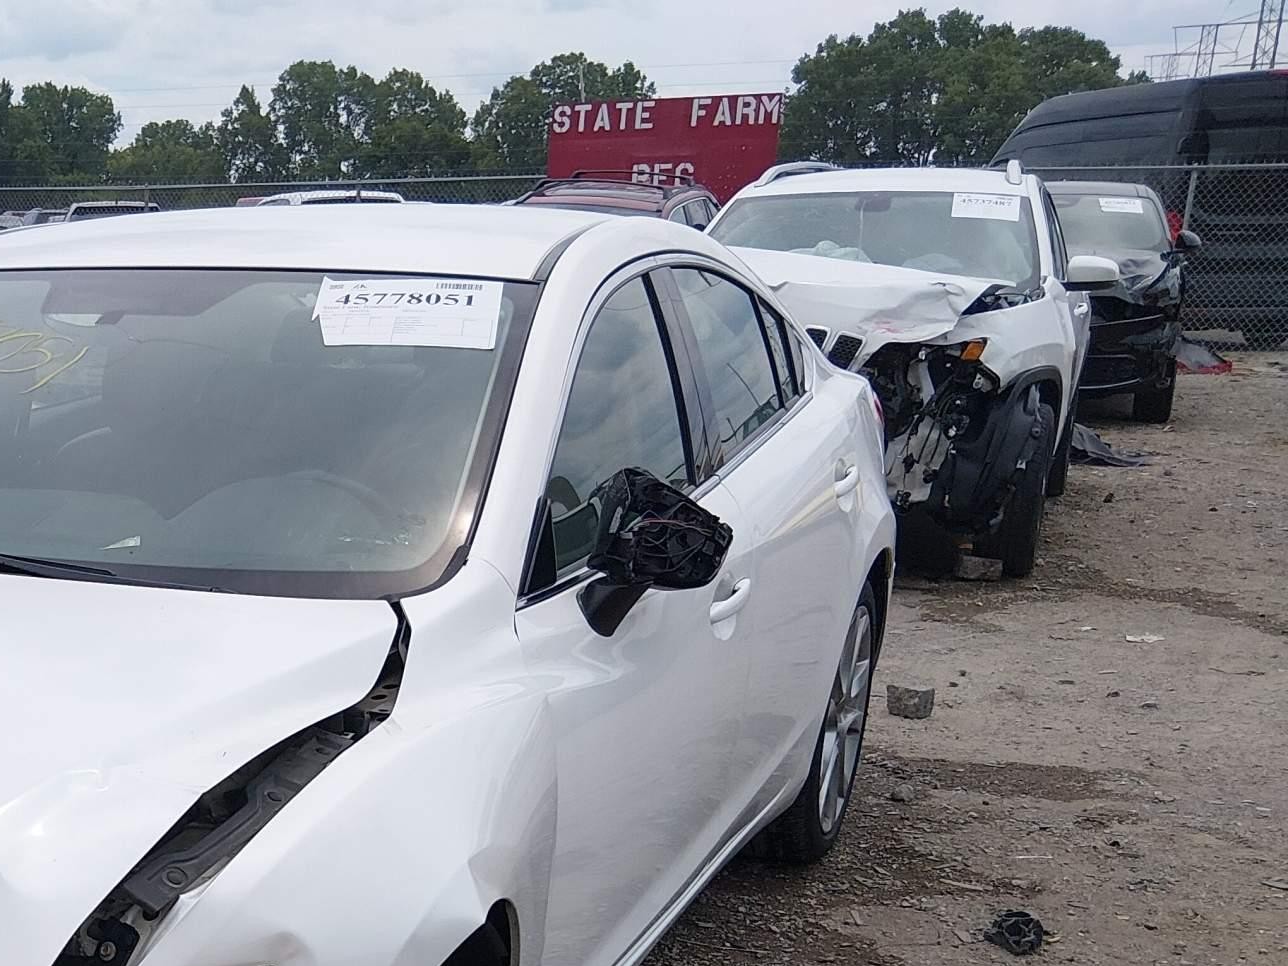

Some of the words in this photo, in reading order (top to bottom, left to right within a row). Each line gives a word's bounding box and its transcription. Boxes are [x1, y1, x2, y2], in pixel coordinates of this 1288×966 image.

[553, 101, 656, 133] STATE
[690, 95, 780, 127] FARM
[335, 292, 474, 307] 45778051
